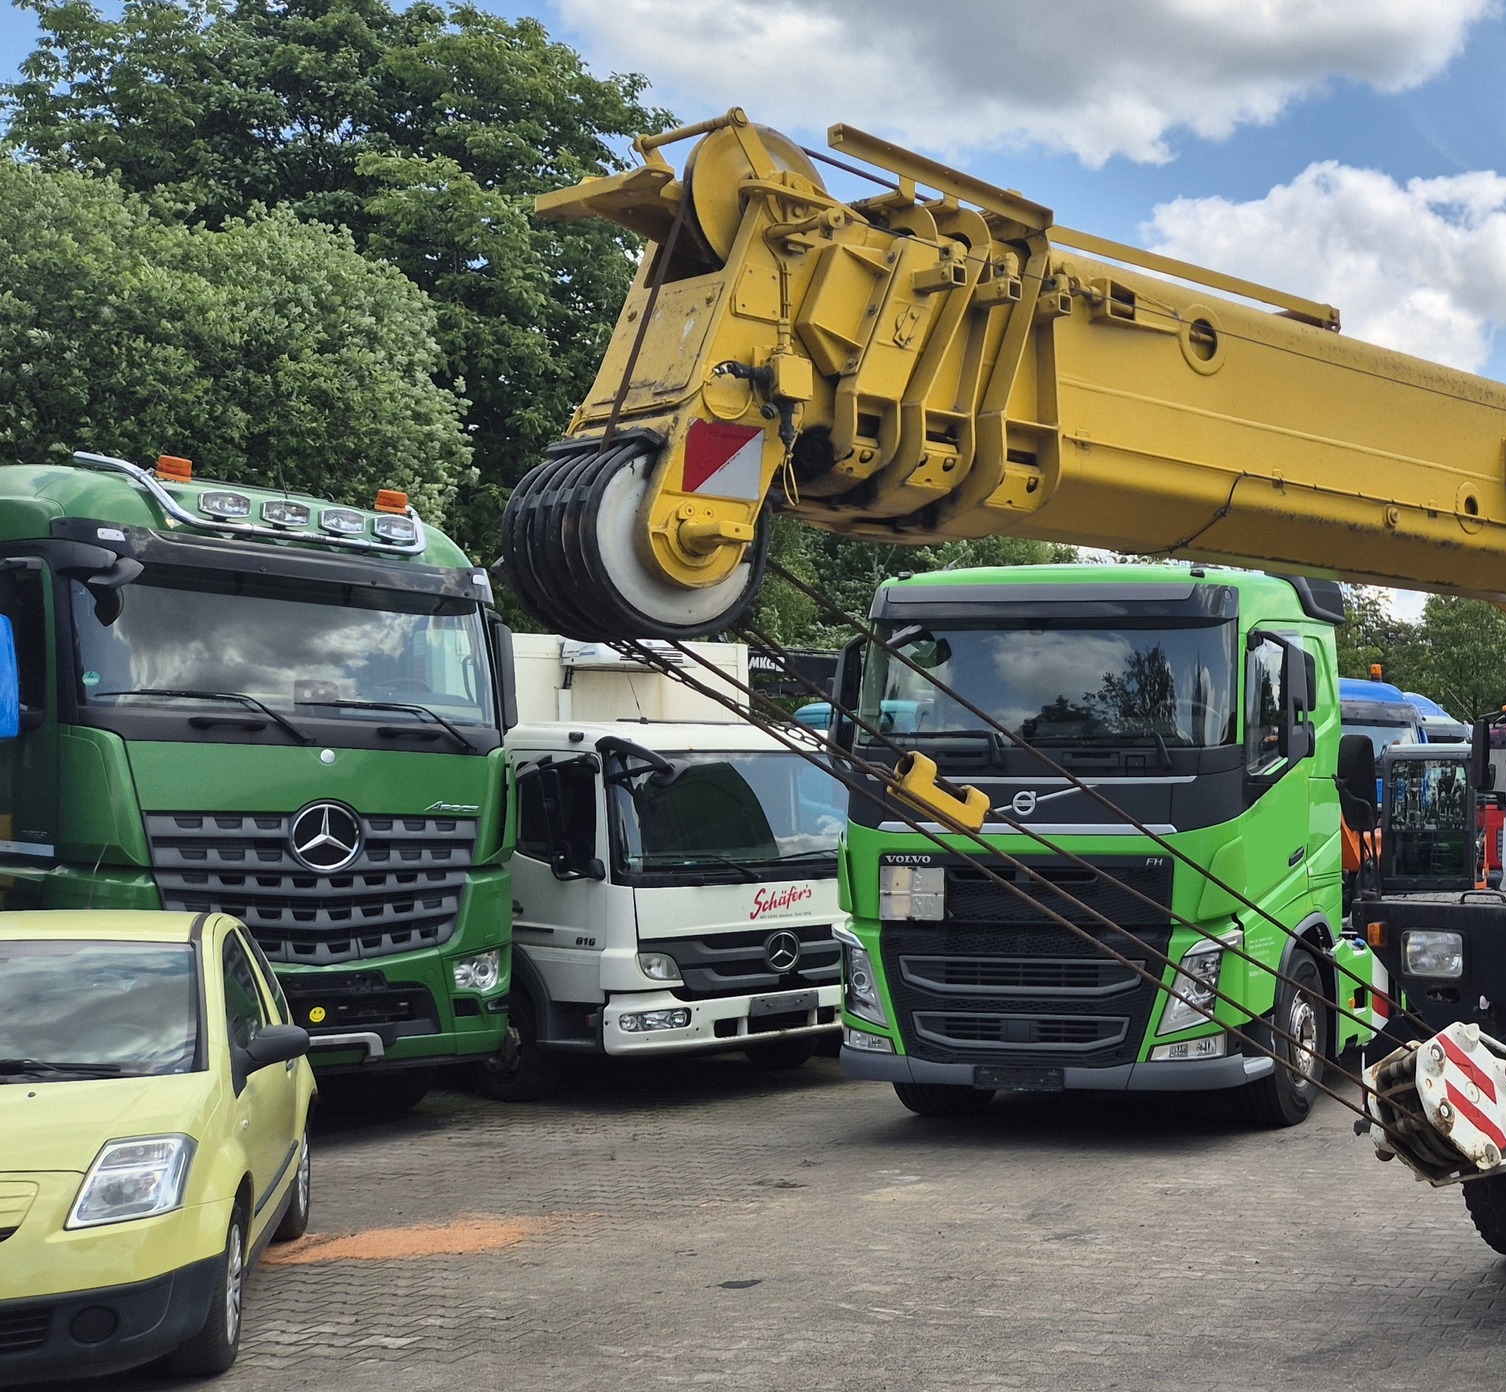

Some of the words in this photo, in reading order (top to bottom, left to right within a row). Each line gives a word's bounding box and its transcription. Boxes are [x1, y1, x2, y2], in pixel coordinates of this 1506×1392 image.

[885, 855, 931, 864] VOLVO
[1145, 857, 1164, 866] FH
[749, 884, 812, 920] Schäfer's
